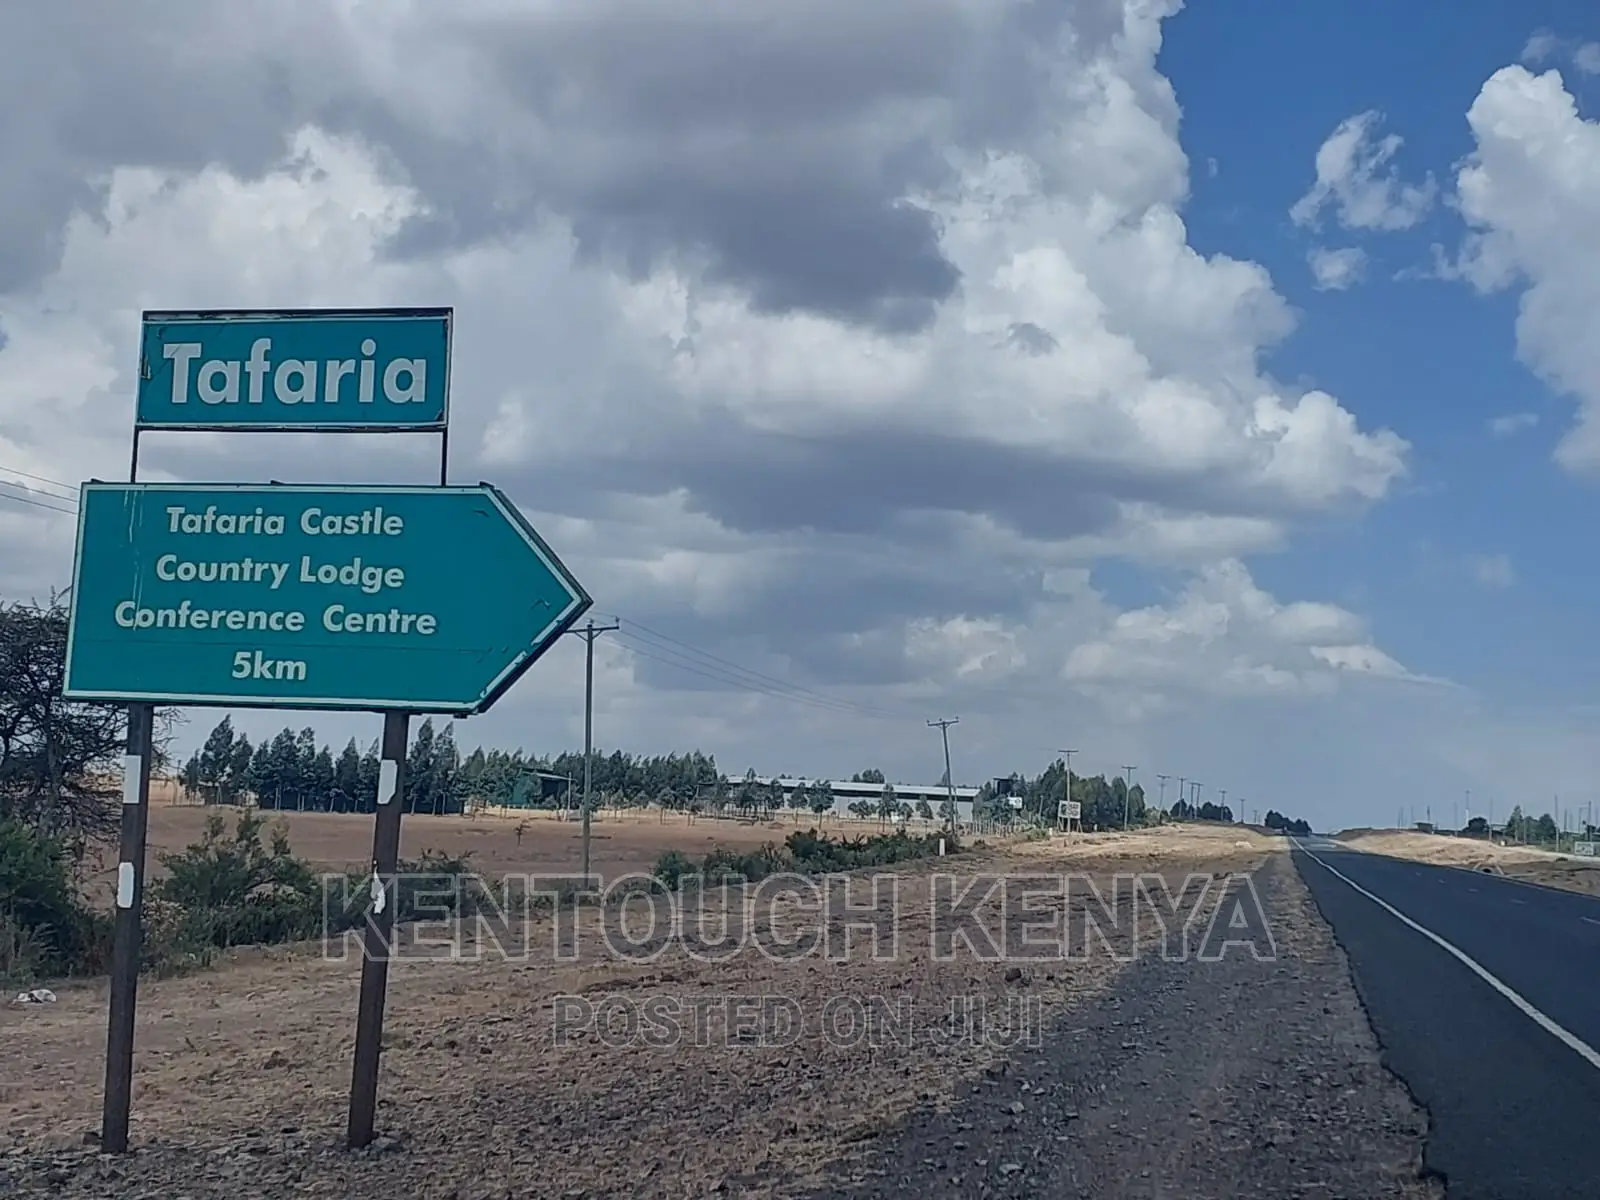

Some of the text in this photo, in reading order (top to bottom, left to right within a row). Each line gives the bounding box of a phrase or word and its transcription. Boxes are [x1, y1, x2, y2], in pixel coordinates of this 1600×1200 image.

[163, 338, 427, 404] Tafaria
[166, 505, 404, 537] Tafaria Castle
[155, 554, 405, 594] Country Lodge
[114, 600, 437, 636] Conference Centre
[232, 651, 307, 681] 5km
